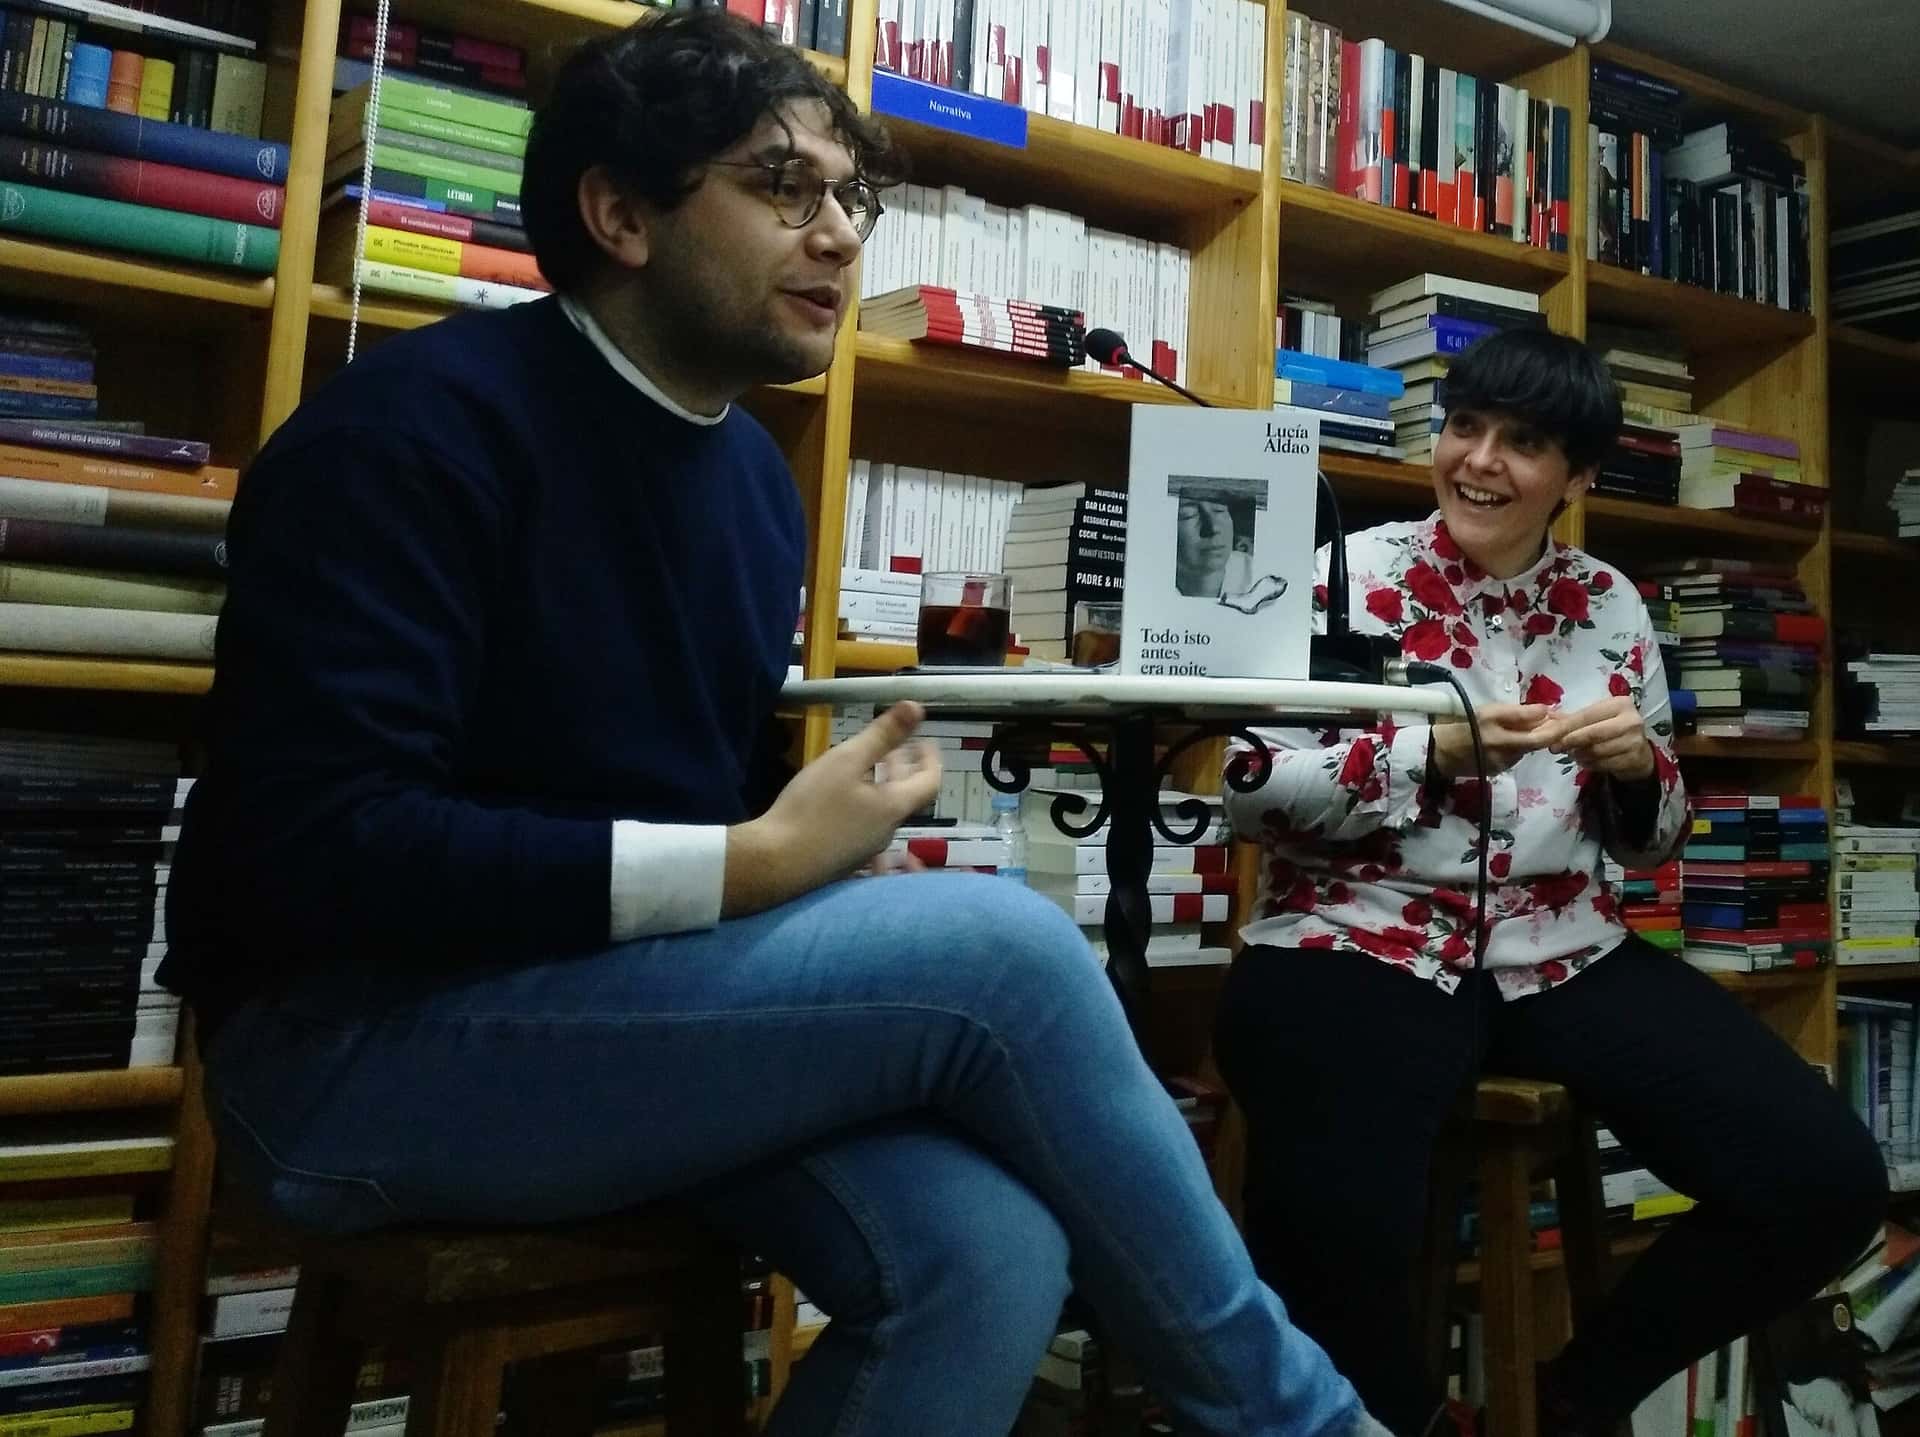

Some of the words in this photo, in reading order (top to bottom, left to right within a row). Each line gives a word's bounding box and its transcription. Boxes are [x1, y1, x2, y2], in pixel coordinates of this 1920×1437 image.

[929, 99, 972, 120] Narrativa
[1266, 422, 1308, 438] Lucía
[1264, 438, 1310, 454] Aldao
[1085, 500, 1098, 510] DAR
[1098, 502, 1106, 512] LA
[1107, 504, 1123, 515] CARA
[1078, 529, 1098, 540] COCHE
[1078, 546, 1115, 561] MANIFIESTO
[1076, 572, 1103, 587] PADRE
[1104, 575, 1112, 588] &
[1140, 627, 1180, 645] Todo
[1184, 629, 1211, 646] isto
[1140, 646, 1181, 660] antes
[1140, 663, 1164, 676] era
[1169, 660, 1208, 677] noite
